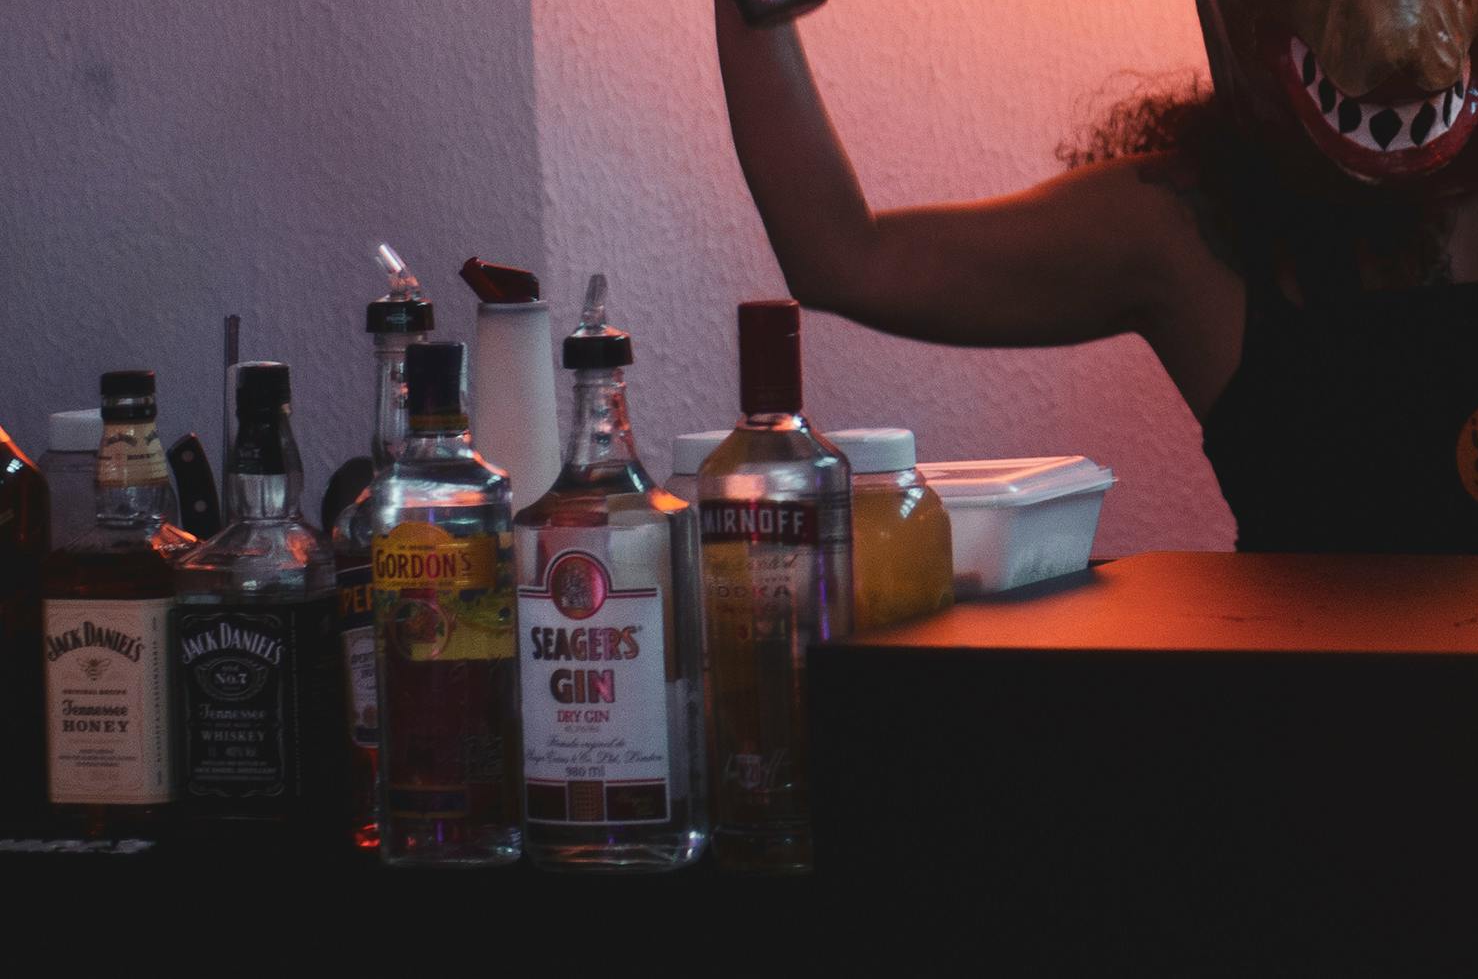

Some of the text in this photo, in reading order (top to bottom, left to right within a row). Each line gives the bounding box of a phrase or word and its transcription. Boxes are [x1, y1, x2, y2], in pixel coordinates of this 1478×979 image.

[376, 549, 472, 579] GORDON'S
[46, 621, 145, 663] JACK DANIEL'S
[181, 622, 285, 666] JACK DANIEL'S
[550, 668, 616, 704] GIN
[62, 699, 129, 717] Tennessee
[199, 703, 266, 721] Tennessee
[557, 710, 609, 723] DRY GIN
[62, 720, 130, 733] HONEY
[200, 729, 266, 743] WHISKEY
